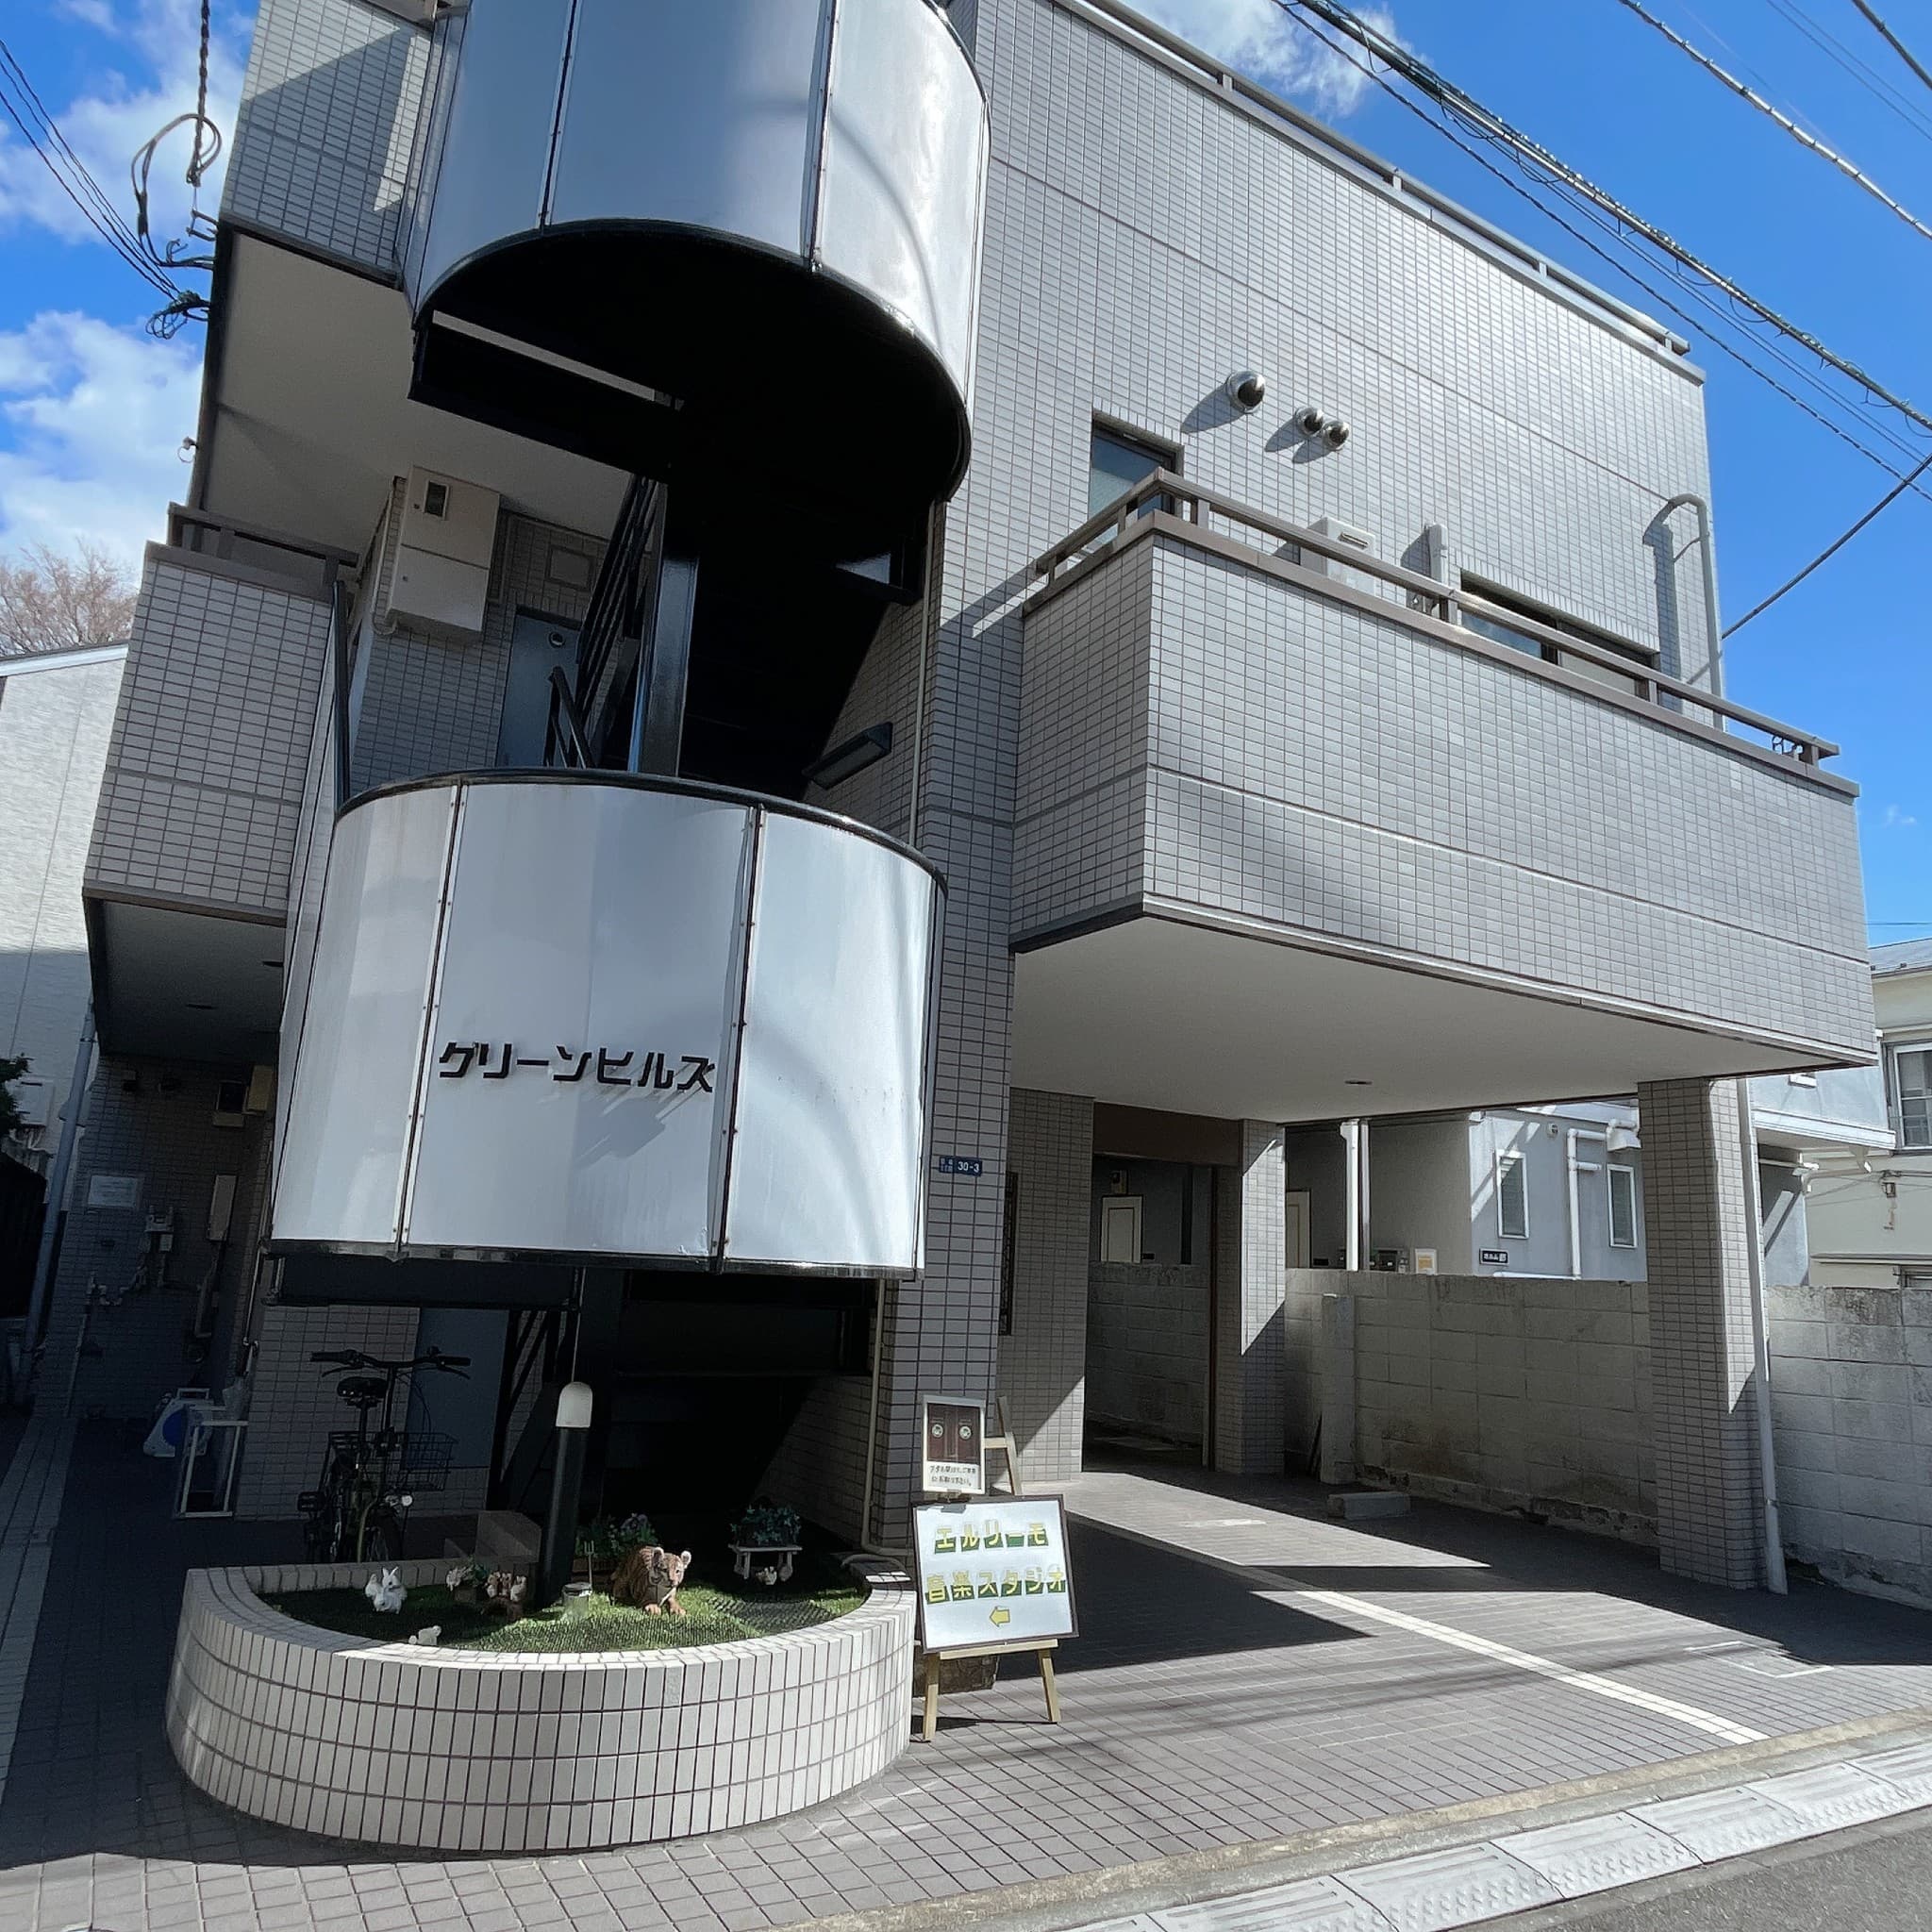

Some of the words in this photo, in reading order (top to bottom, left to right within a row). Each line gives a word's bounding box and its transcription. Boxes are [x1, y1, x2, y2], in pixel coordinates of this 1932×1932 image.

[958, 1161, 979, 1173] 30-3
[935, 1521, 1048, 1552] エルリーモ
[926, 1566, 1066, 1603] 音楽スタジオ
